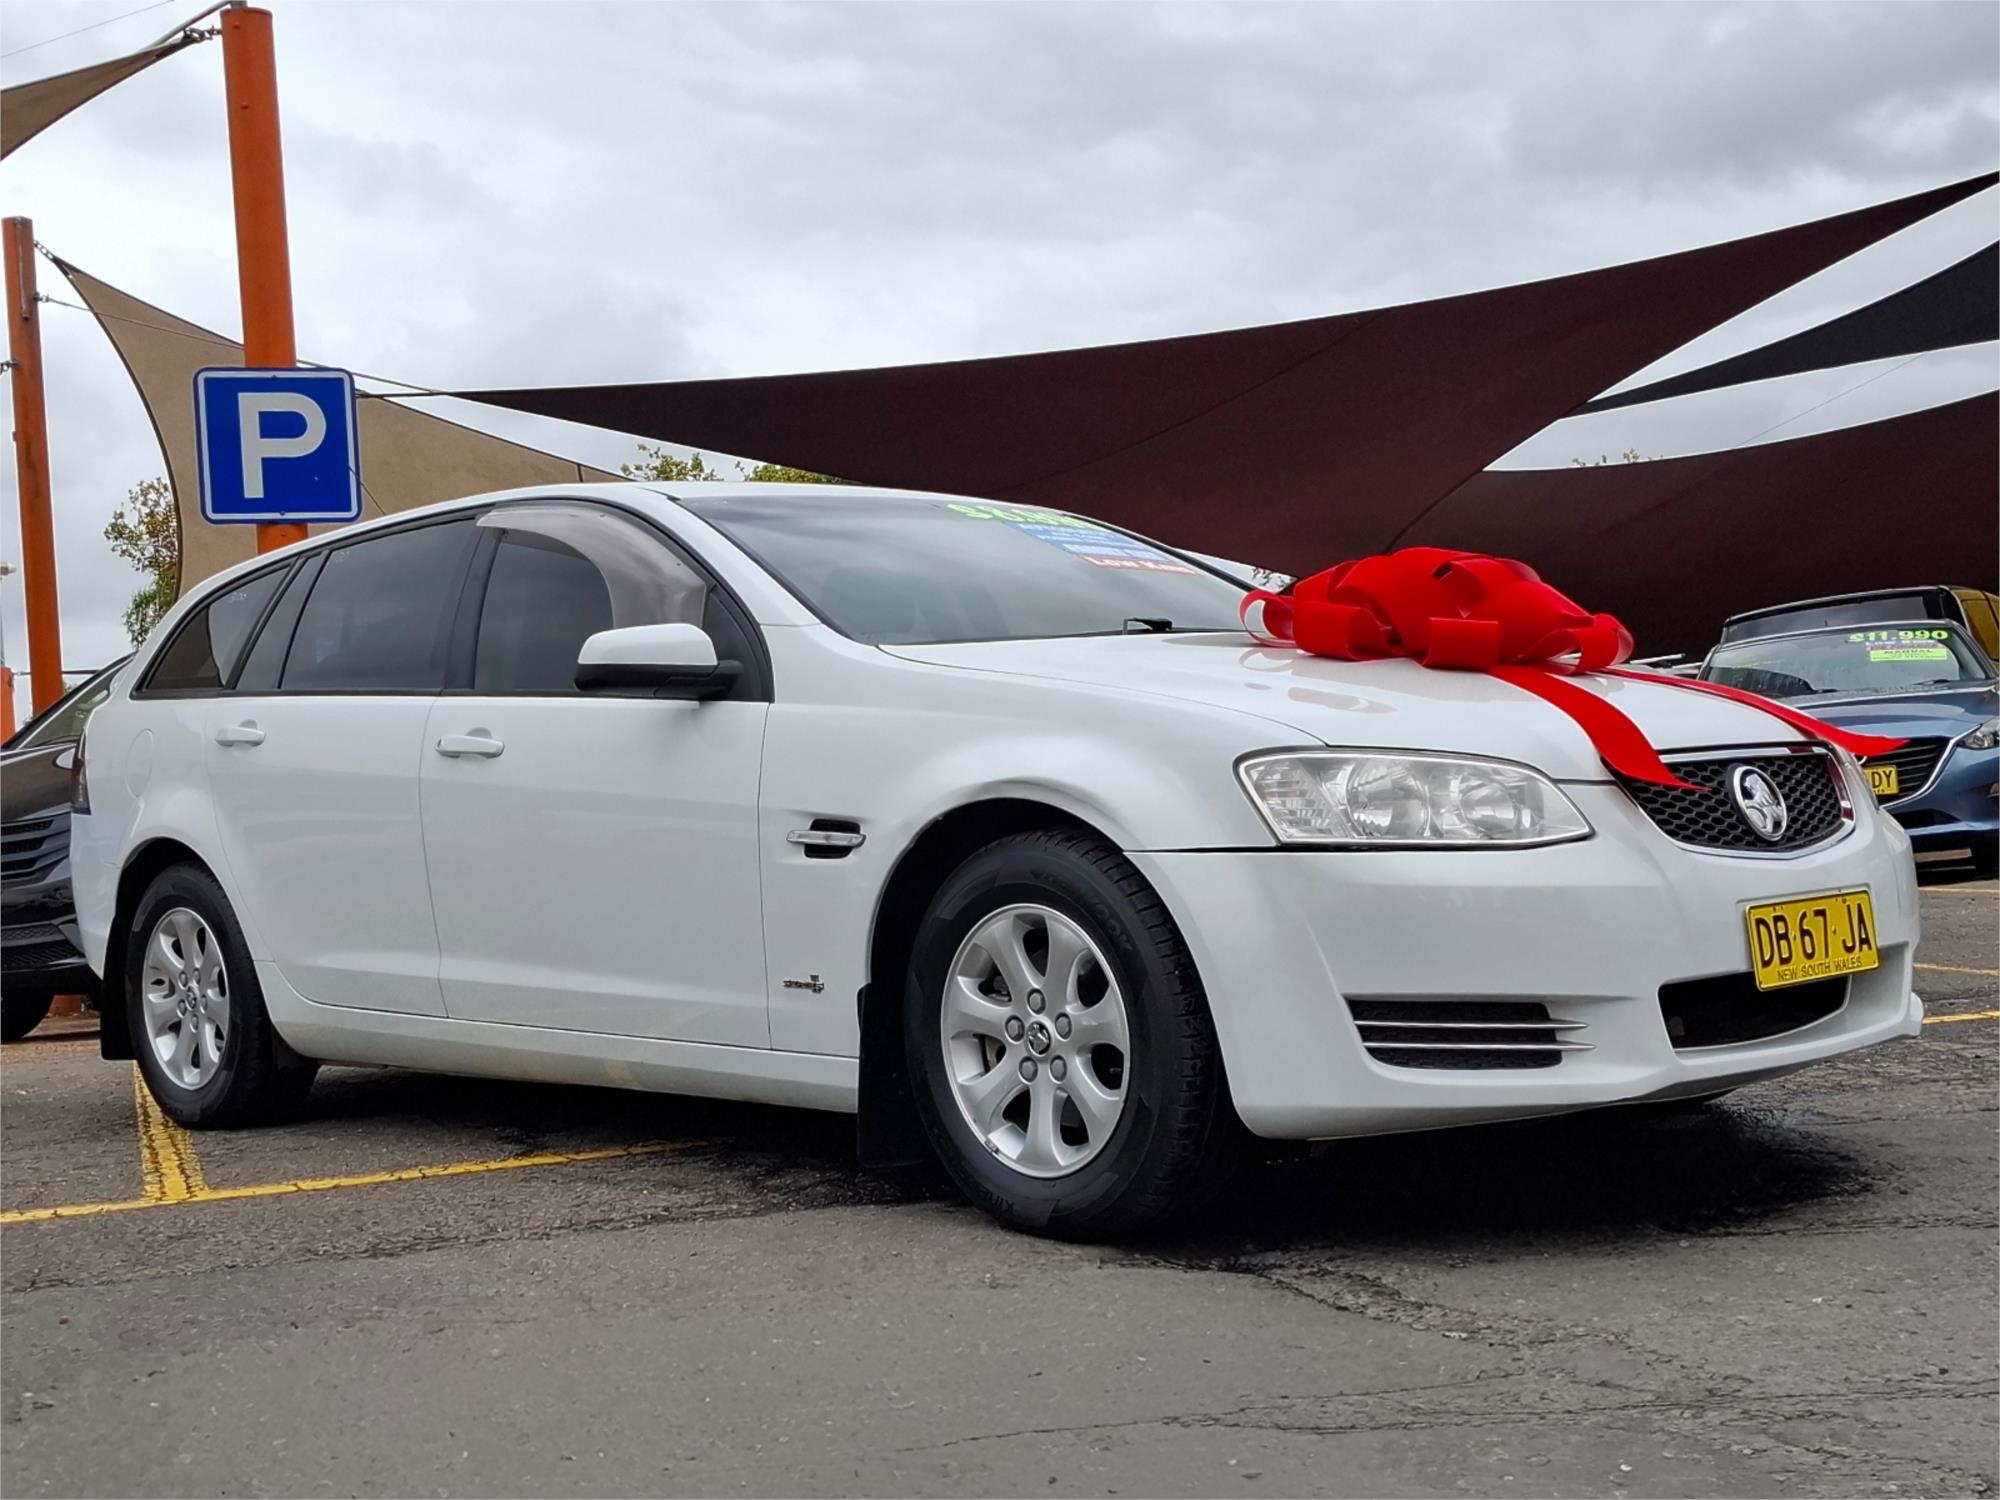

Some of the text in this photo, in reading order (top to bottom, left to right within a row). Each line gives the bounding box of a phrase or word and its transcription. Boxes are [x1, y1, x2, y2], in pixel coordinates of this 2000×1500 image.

[237, 392, 327, 498] P
[1871, 770, 1893, 788] DY
[1754, 902, 1872, 968] DB 67 JA
[1777, 956, 1862, 981] NEW SOUTH WALES
